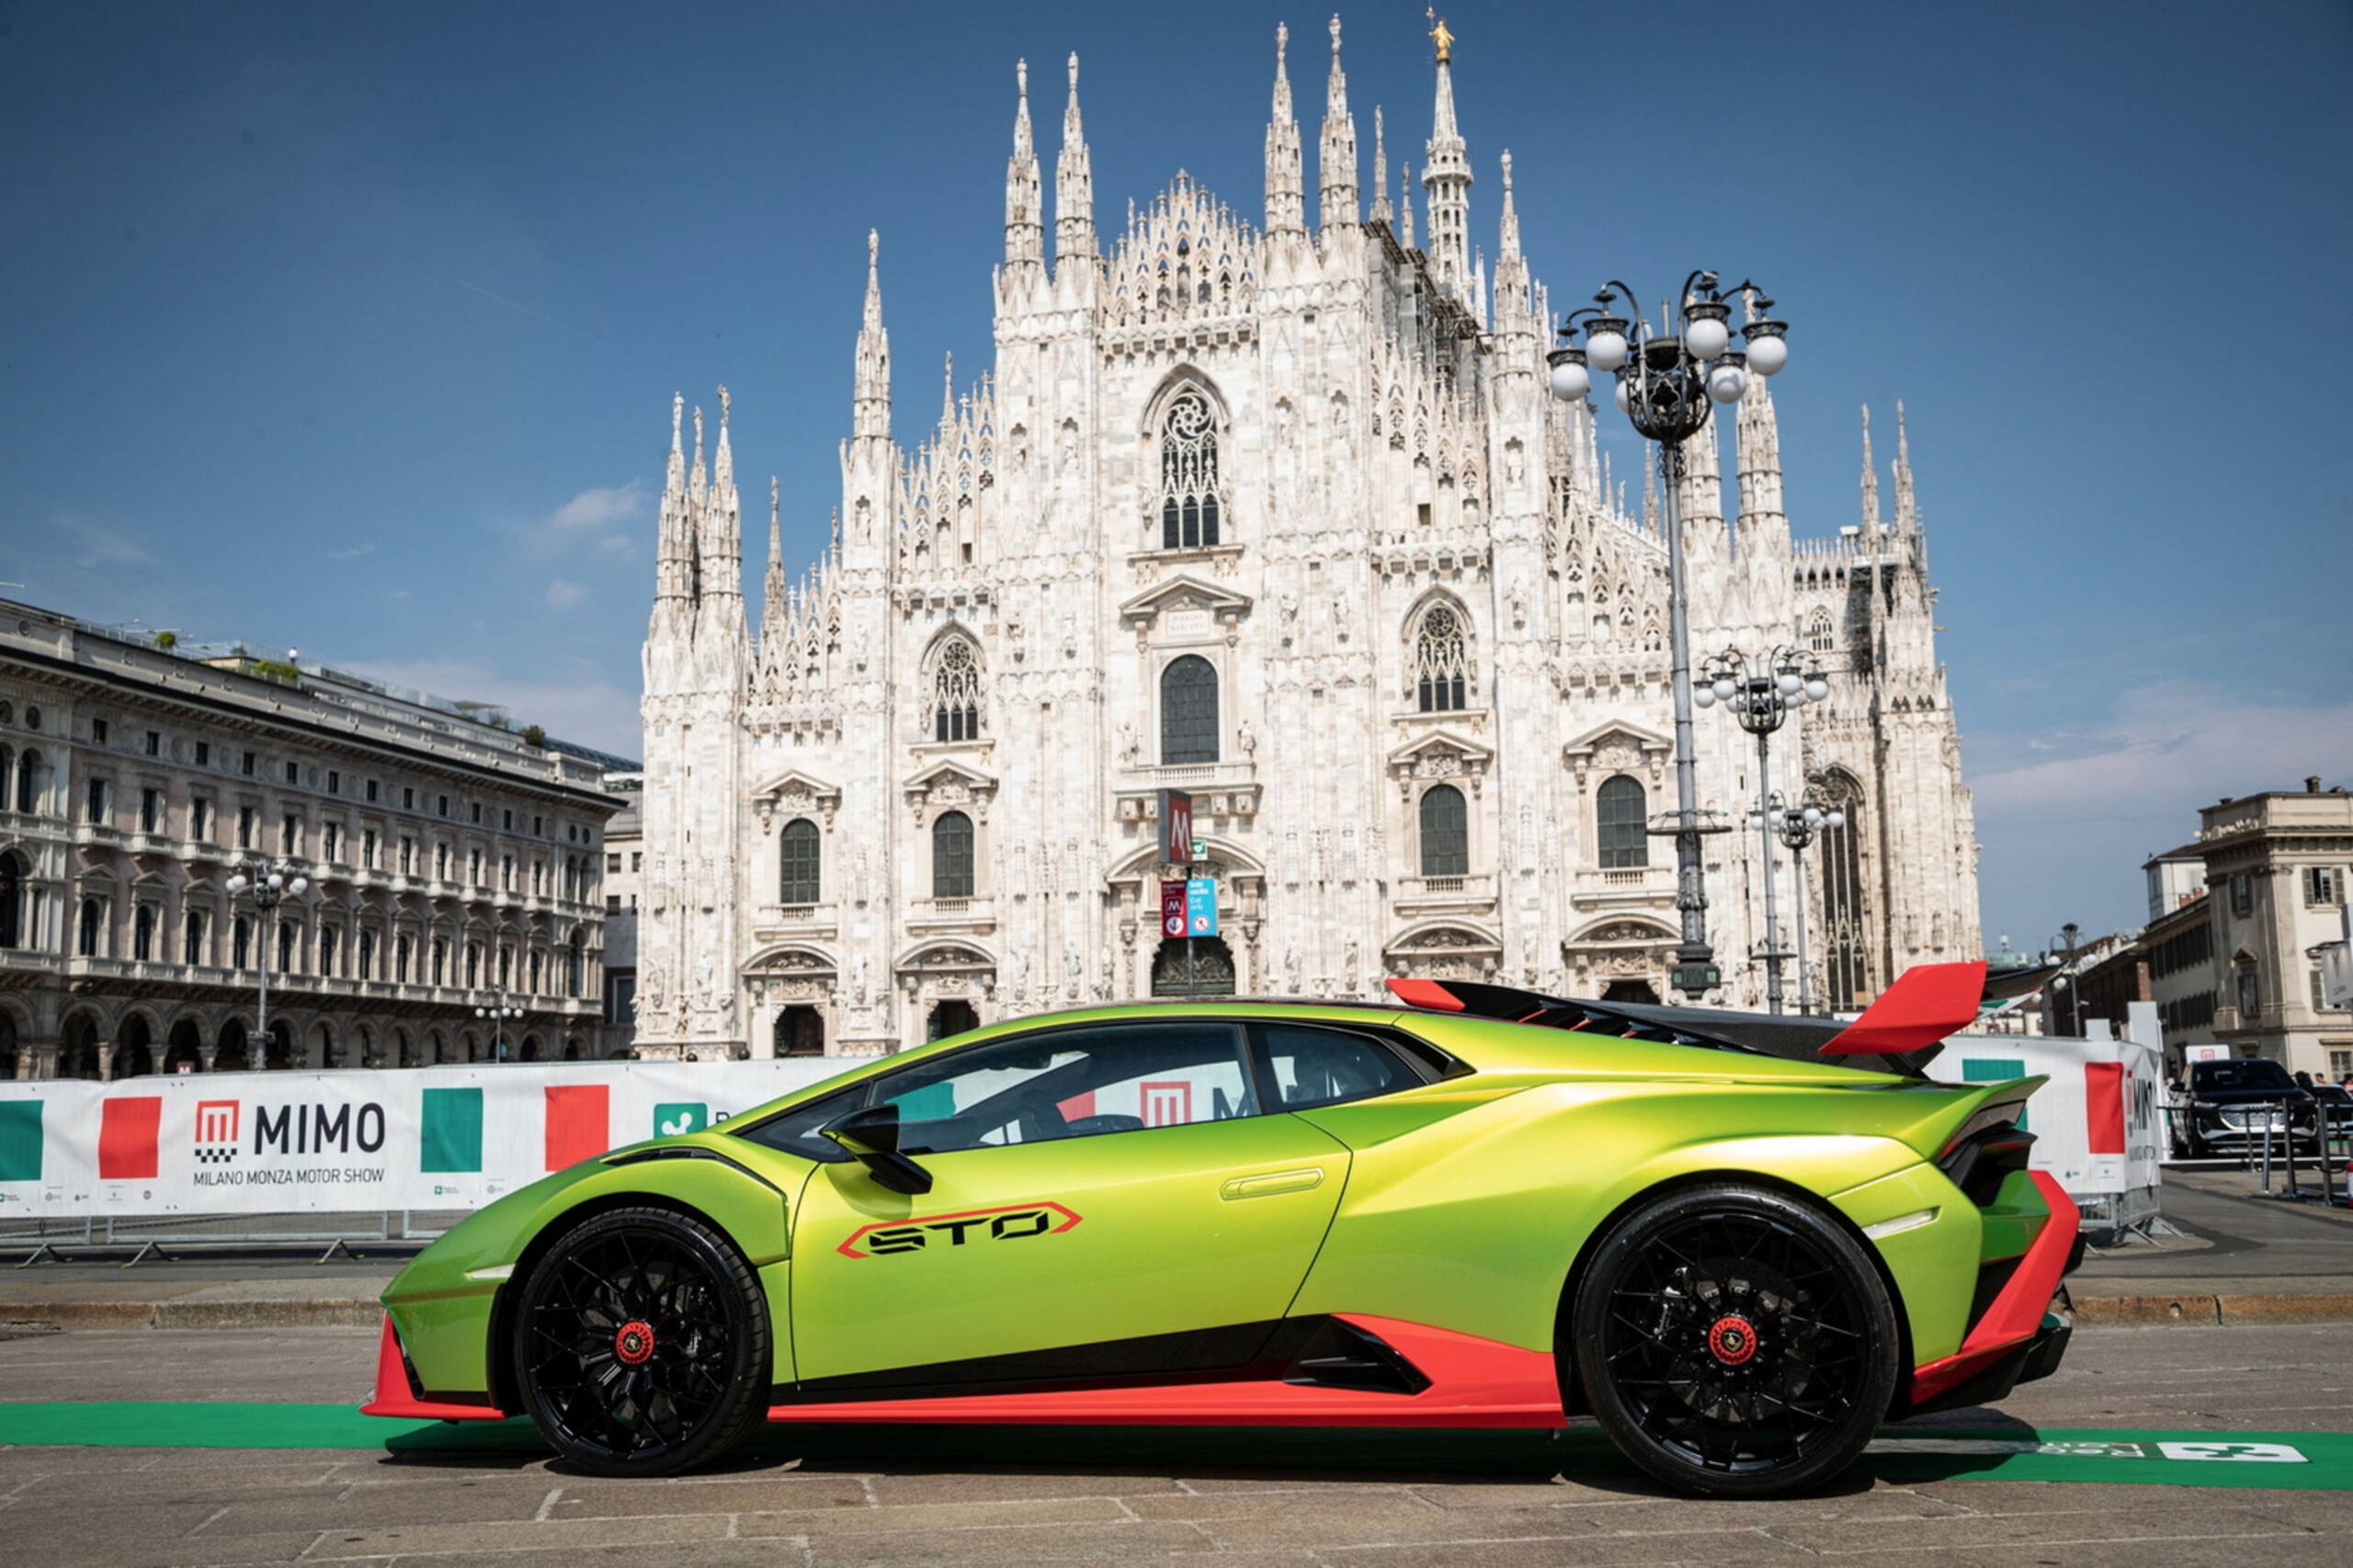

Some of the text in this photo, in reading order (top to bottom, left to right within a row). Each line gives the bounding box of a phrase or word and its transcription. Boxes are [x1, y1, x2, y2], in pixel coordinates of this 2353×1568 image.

[1171, 809, 1191, 859] M
[1168, 900, 1181, 911] M
[254, 1102, 386, 1155] MIMO
[193, 1167, 385, 1187] MILANO MONZA MOTOR SHOW
[869, 1210, 1050, 1256] STO
